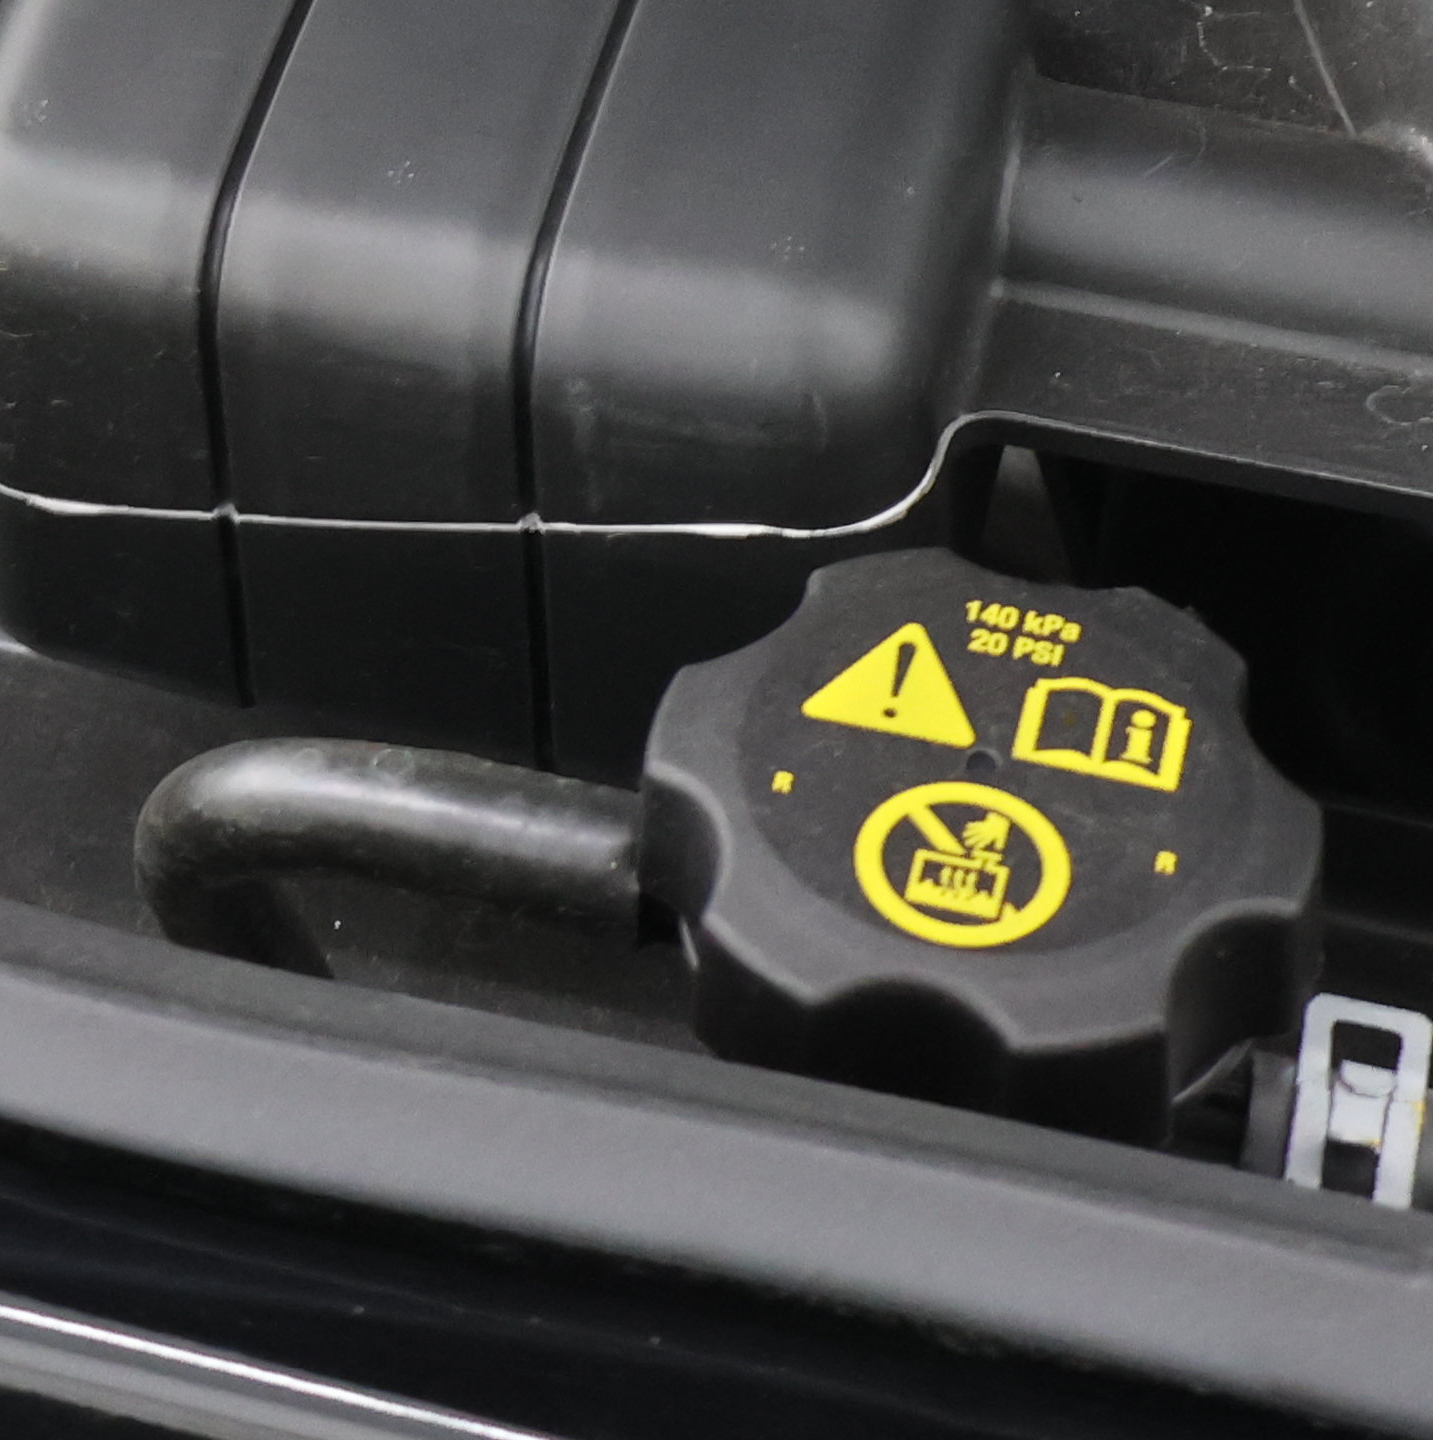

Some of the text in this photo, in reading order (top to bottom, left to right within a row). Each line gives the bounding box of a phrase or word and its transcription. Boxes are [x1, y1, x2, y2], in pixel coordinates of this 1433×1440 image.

[965, 600, 1082, 643] 140 kPa
[967, 628, 1065, 667] 20 PSI
